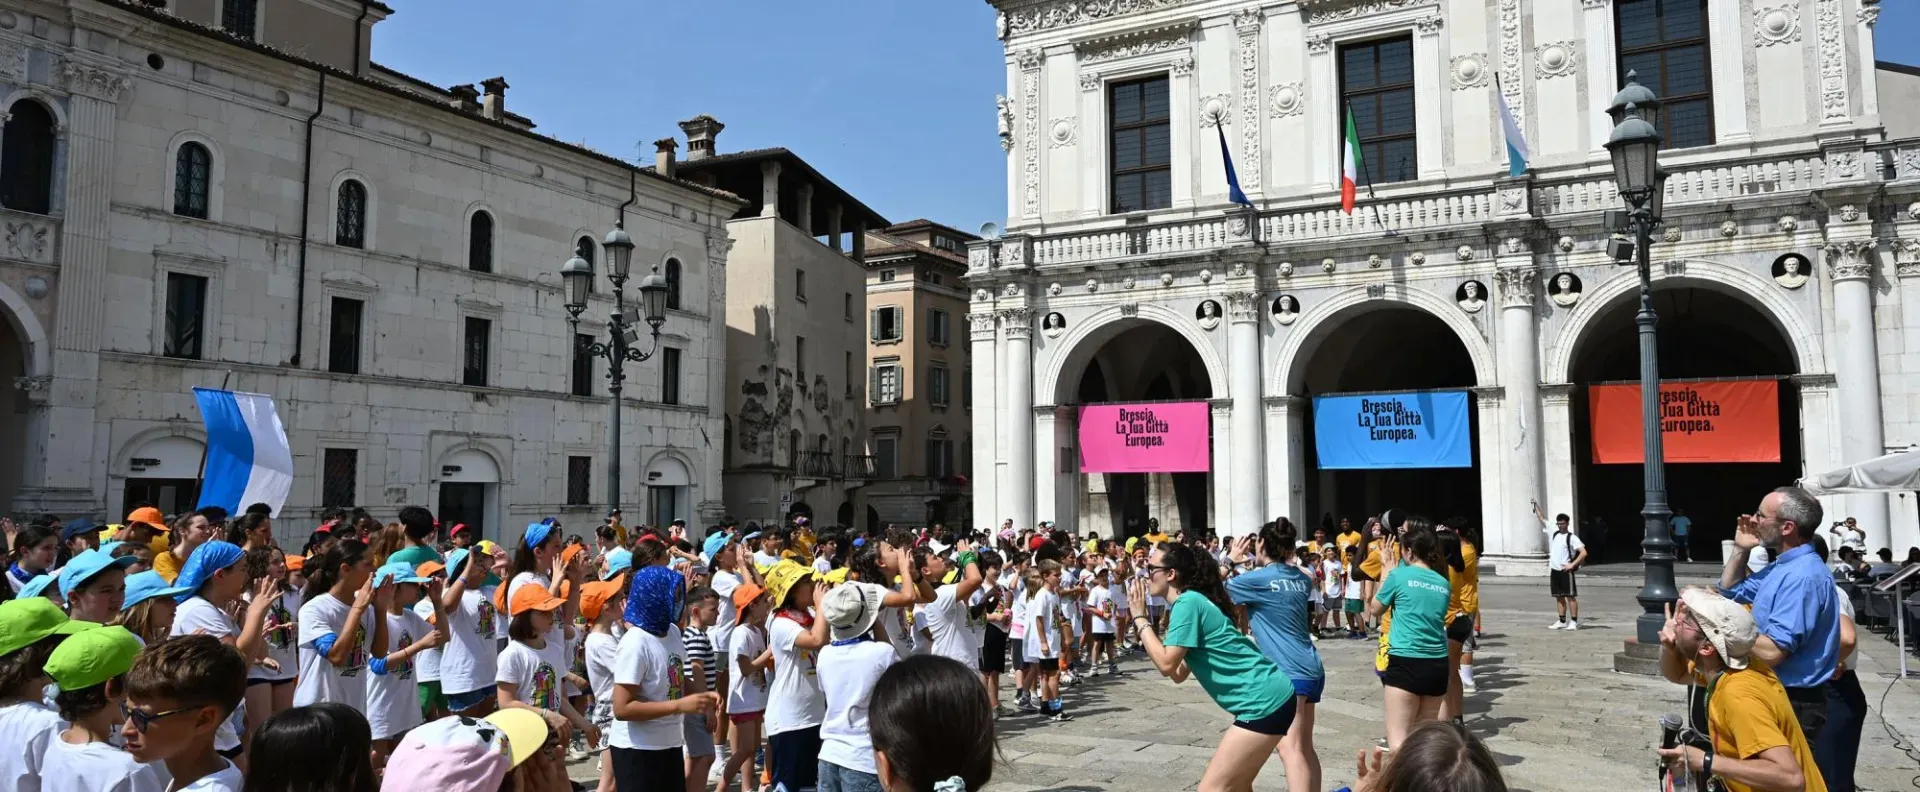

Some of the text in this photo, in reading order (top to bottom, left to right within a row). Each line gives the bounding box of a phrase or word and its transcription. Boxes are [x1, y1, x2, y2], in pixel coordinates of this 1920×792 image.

[1661, 400, 1720, 417] Tua Città
[1116, 420, 1169, 434] La Tua Città
[1358, 411, 1421, 427] La Tua Città
